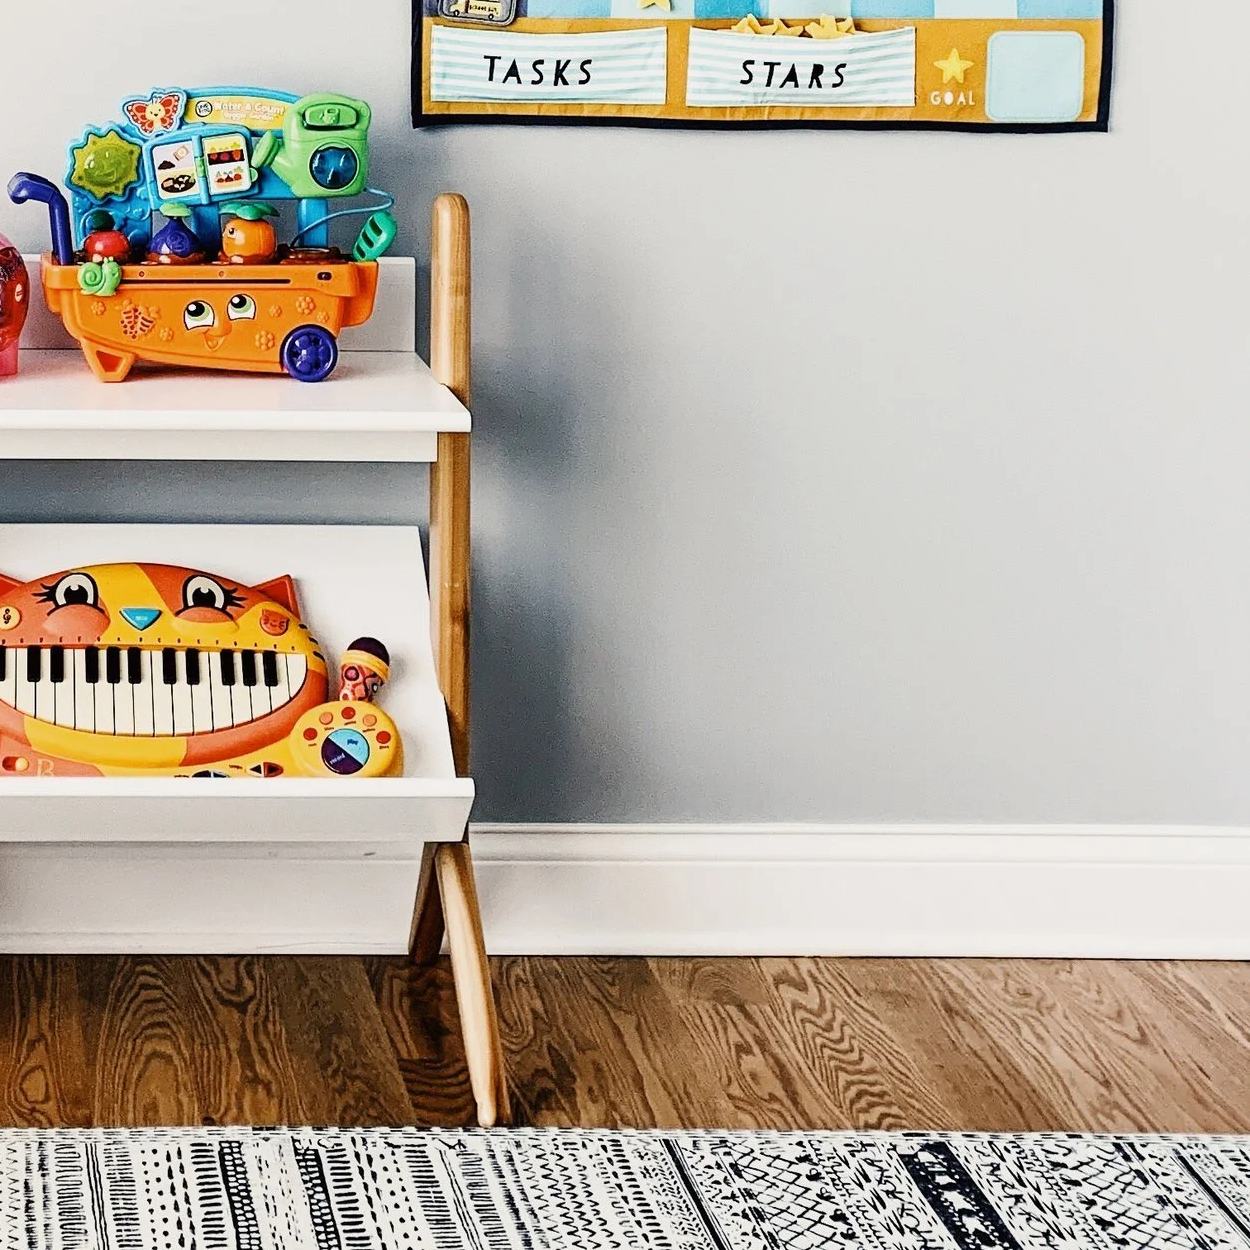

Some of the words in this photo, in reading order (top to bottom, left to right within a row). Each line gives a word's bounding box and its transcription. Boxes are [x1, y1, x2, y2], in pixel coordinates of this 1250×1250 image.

[483, 55, 593, 87] TASKS
[739, 58, 847, 89] STARS
[211, 102, 242, 111] Water
[255, 102, 285, 116] Count
[930, 90, 976, 106] GOAL
